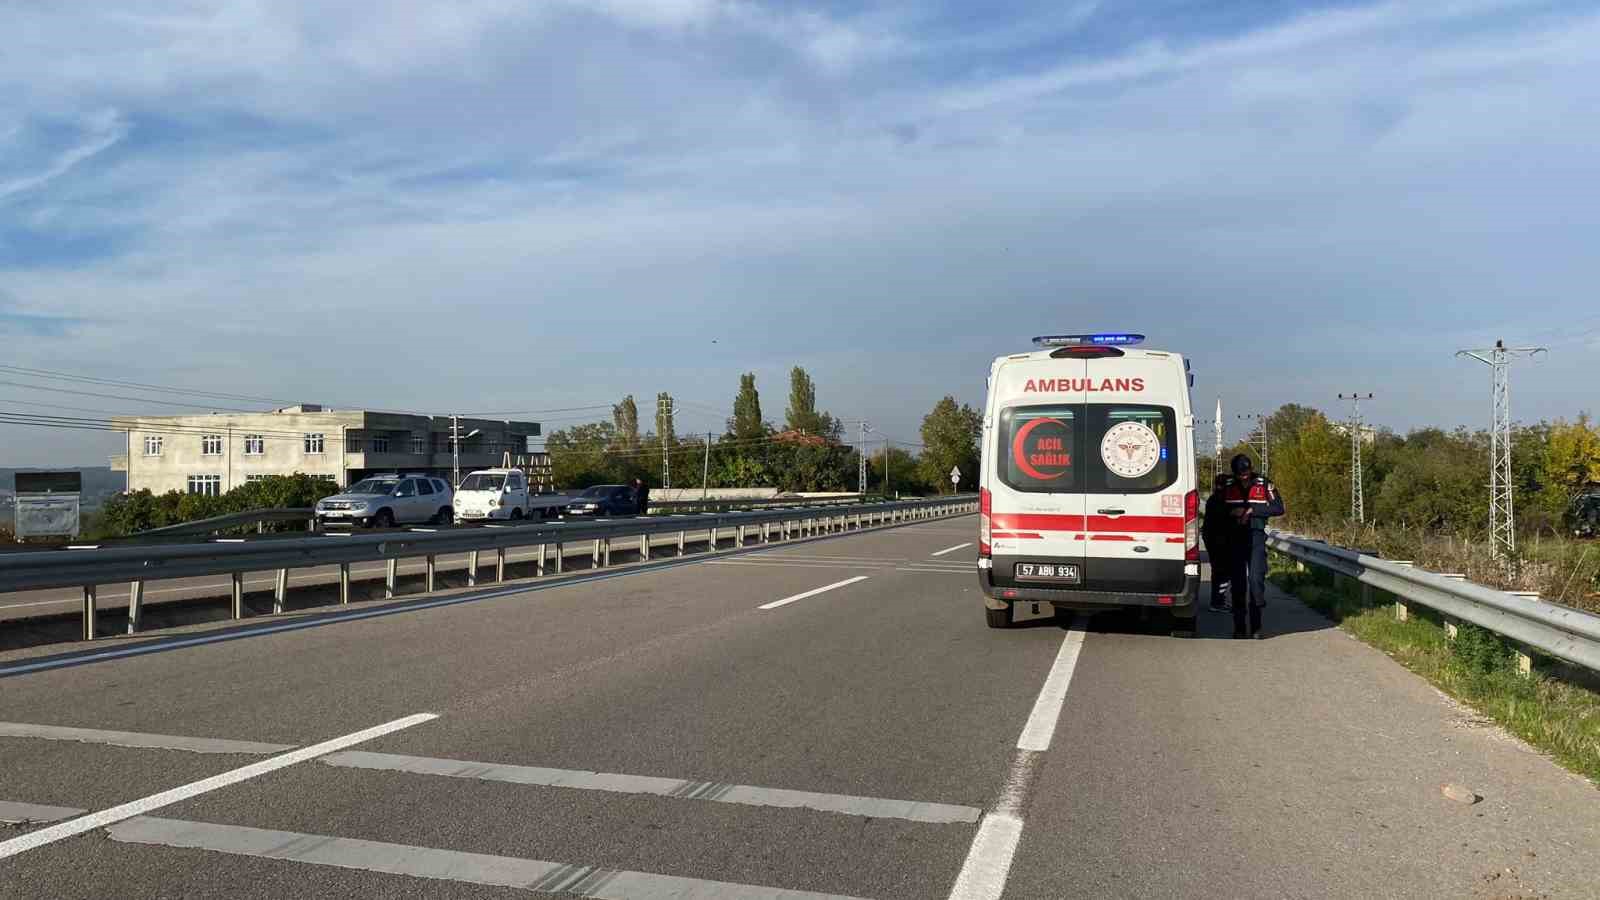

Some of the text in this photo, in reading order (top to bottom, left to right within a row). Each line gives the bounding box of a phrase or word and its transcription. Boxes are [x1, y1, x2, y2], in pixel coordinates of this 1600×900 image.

[1024, 378, 1145, 392] AMBULANS
[1022, 565, 1034, 576] 57
[1058, 567, 1074, 577] 934
